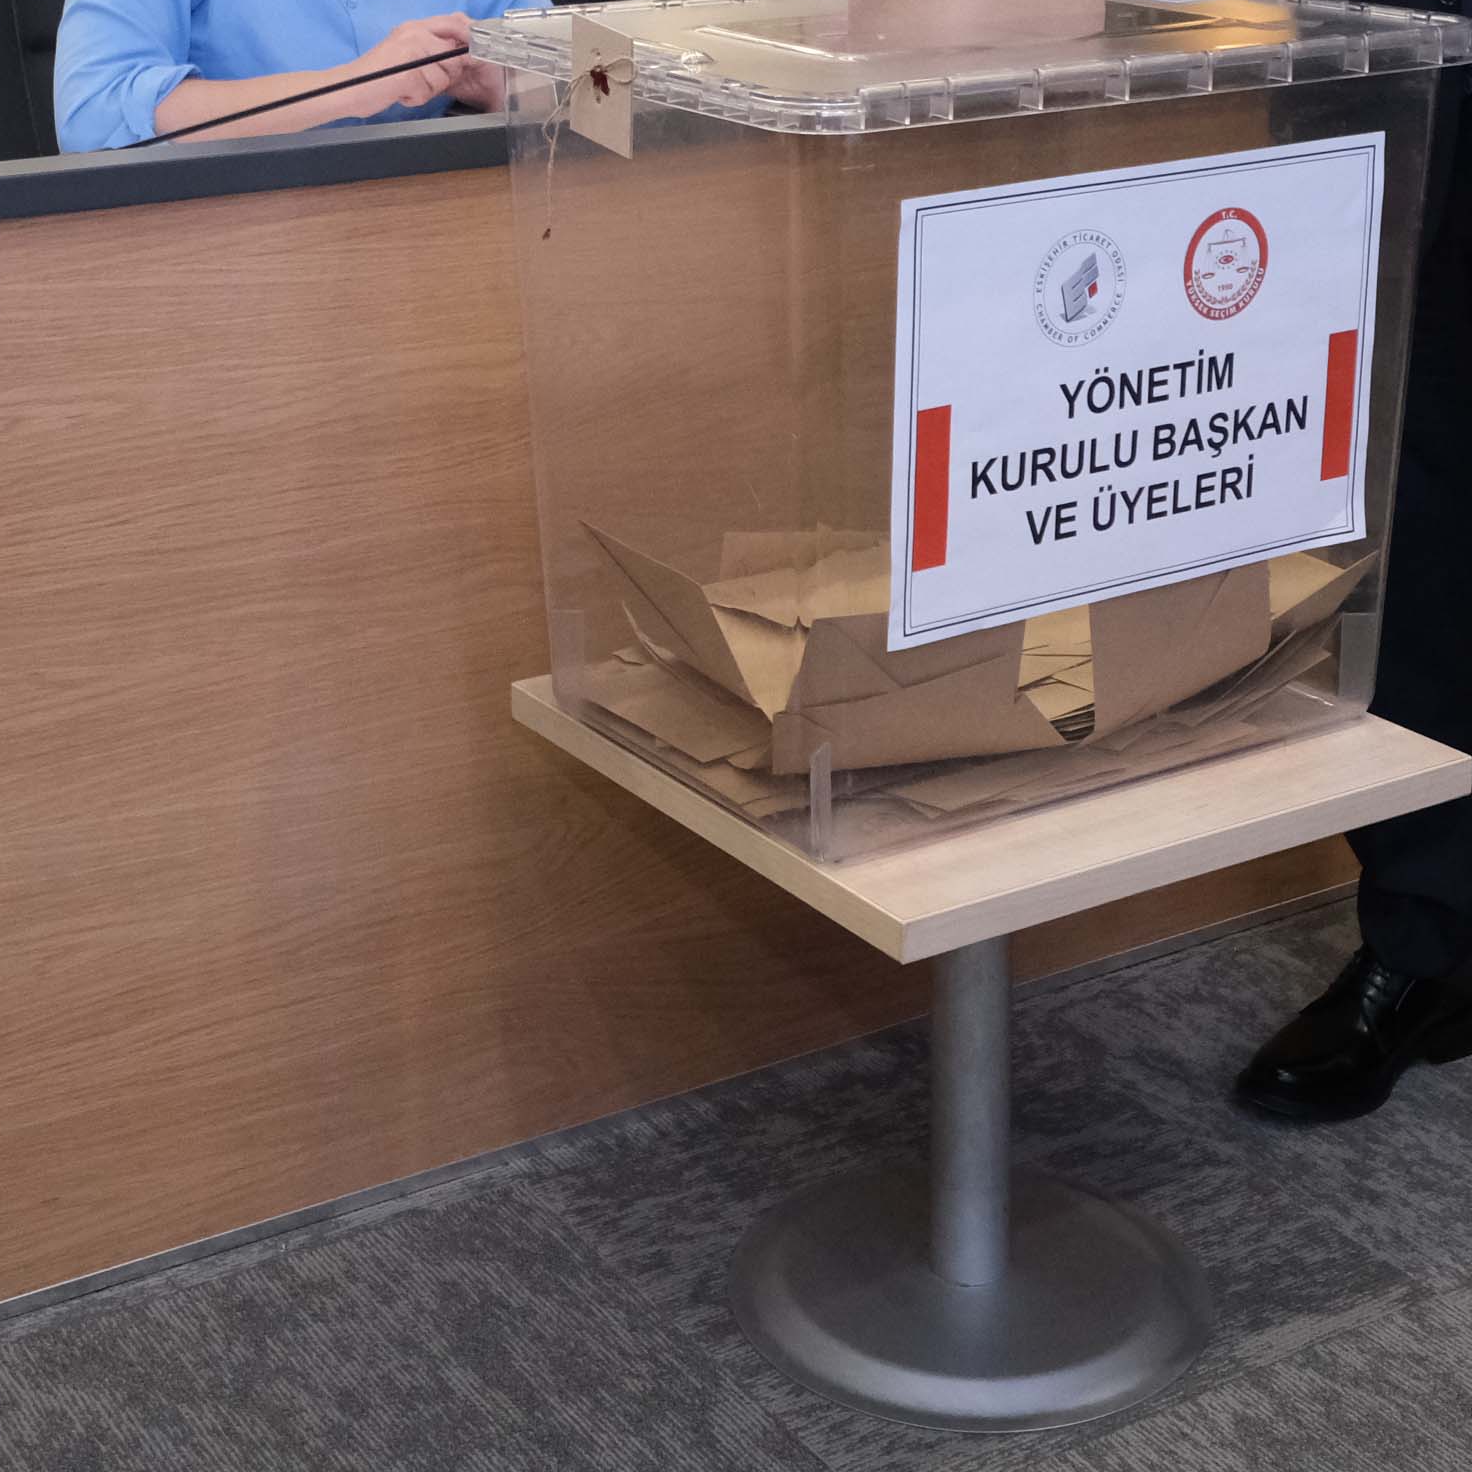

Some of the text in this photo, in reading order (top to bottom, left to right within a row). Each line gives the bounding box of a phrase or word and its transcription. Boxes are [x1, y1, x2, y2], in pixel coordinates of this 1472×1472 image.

[1112, 250, 1124, 282] ODASI
[1036, 293, 1122, 343] CHAMBER OF COMMERCE
[1059, 349, 1234, 419] YÖNETİM
[971, 395, 1308, 499] KURULU BAŞKAN
[1026, 454, 1254, 545] VE ÜYELERİ
